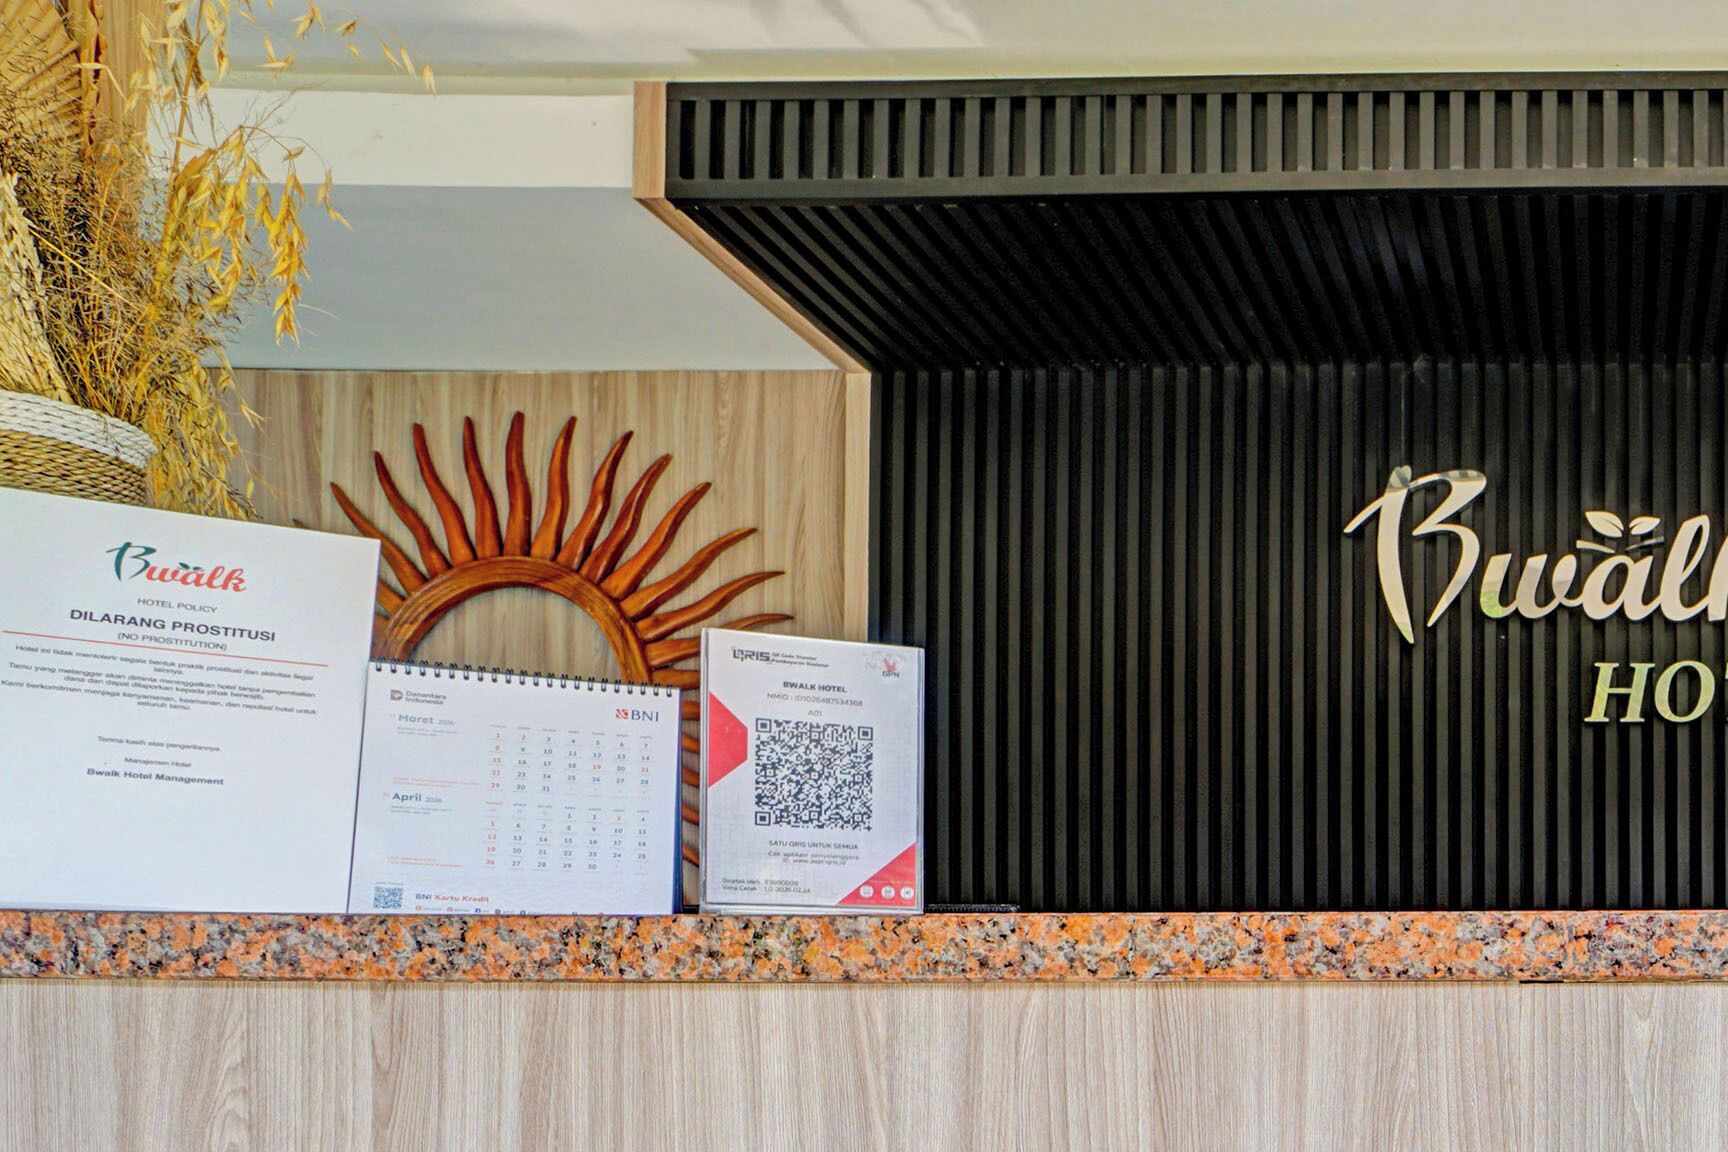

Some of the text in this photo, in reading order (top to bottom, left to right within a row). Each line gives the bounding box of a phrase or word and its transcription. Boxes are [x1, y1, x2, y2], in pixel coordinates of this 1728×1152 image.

[137, 598, 218, 613] HOTEL POLICY
[70, 609, 276, 642] DILARANG PROSTITUSI
[118, 632, 227, 651] (NO PROSTITUTION)
[15, 645, 39, 653] Hotel
[53, 648, 73, 656] tidak
[119, 655, 147, 664] segala
[149, 658, 176, 667] bentuk
[206, 665, 242, 674] prostitusi
[732, 648, 770, 662] QRIS
[8, 661, 32, 670] Tamu
[34, 665, 56, 674] yang
[58, 668, 103, 678] melanggar
[127, 674, 157, 683] diminta
[159, 677, 216, 689] meninggalkan
[217, 683, 237, 691] hotel
[64, 675, 86, 683] dana
[105, 679, 130, 688] dapat
[131, 681, 174, 691] dilaporkan
[175, 686, 205, 695] kepada
[207, 688, 228, 697] pihak
[783, 681, 847, 693] BWALK HOTEL
[1, 679, 25, 688] Kami
[26, 682, 82, 693] berkomitmen
[84, 687, 121, 697] menjaga
[275, 705, 294, 713] hotel
[296, 707, 317, 715] untuk
[405, 697, 444, 705] Indonesia
[406, 690, 447, 700] Danantara
[767, 692, 788, 700] NMID
[398, 714, 435, 724] Maret
[631, 709, 659, 722] BNI
[808, 709, 822, 717] A01
[98, 735, 124, 744] Terima
[171, 760, 192, 768] Hotel
[86, 768, 224, 785] Bwalk Hotel Management
[392, 792, 422, 803] April
[434, 894, 460, 902] Kartu
[462, 895, 489, 903] Kredit
